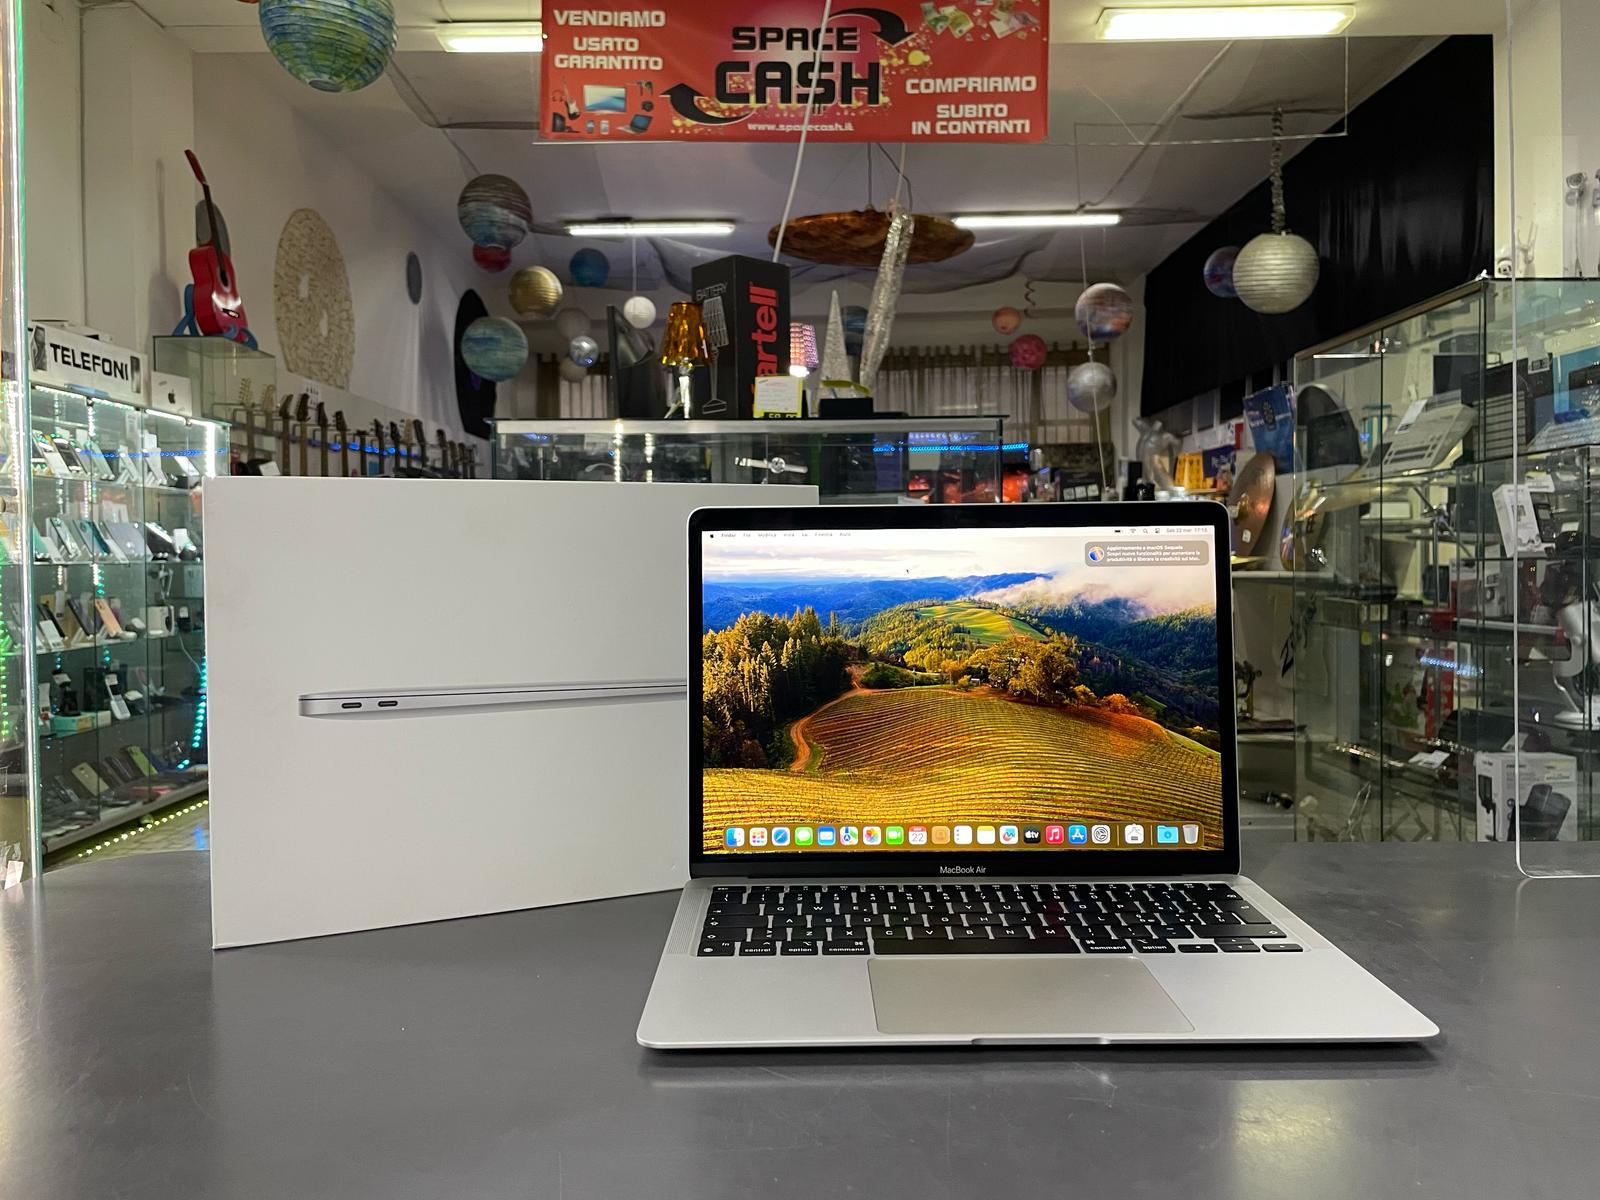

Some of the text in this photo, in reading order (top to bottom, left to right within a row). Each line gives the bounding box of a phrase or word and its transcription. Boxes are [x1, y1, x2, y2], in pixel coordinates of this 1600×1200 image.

[554, 10, 666, 28] VENDIAMO
[573, 37, 639, 52] USATO
[732, 27, 858, 52] SPACE
[554, 54, 664, 71] GARANTITO
[715, 61, 881, 105] CASH
[905, 76, 1037, 94] COMPRIAMO
[936, 103, 1008, 119] SUBITO
[911, 119, 1031, 135] IN CONTANTI
[750, 284, 778, 390] artell
[50, 343, 129, 380] TELEFONI
[912, 832, 924, 842] 22
[940, 866, 986, 874] MacBook Air
